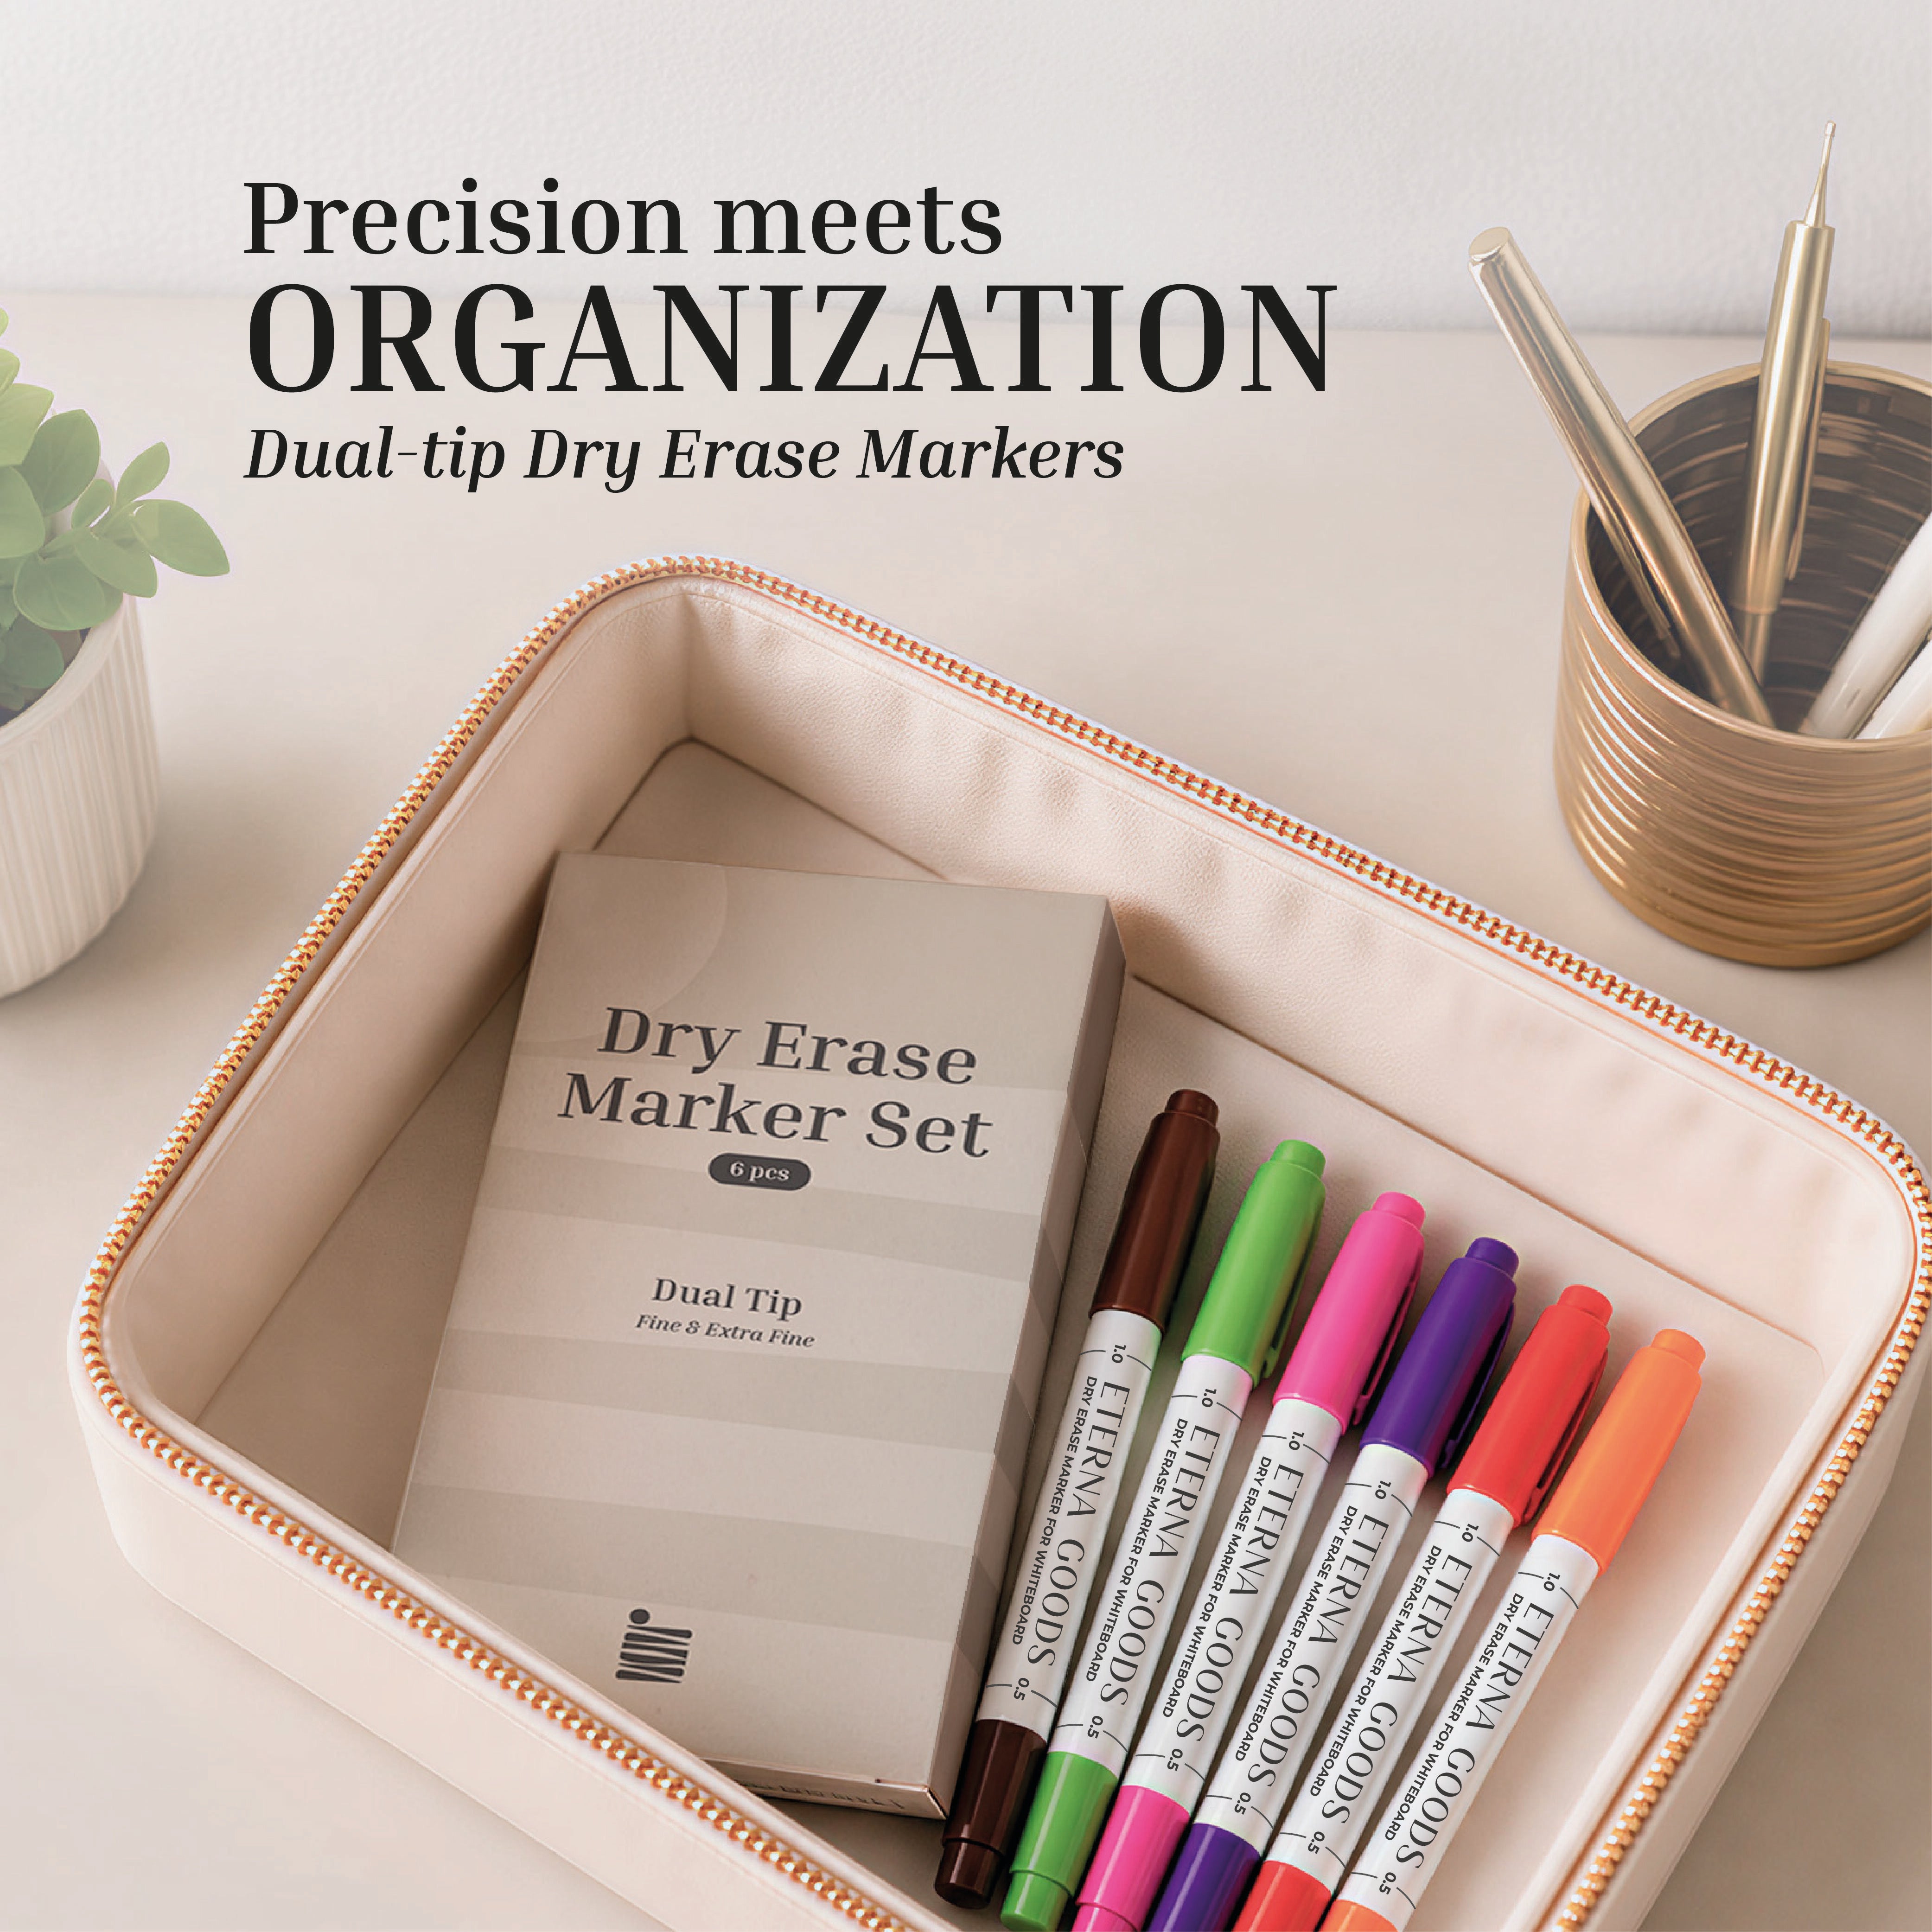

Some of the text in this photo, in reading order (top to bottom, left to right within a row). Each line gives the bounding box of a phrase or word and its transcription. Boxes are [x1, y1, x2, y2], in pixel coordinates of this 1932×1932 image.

[597, 1007, 976, 1084] Dry Erase
[557, 1072, 993, 1157] Marker Set
[730, 1161, 790, 1182] 6 pcs
[652, 1278, 801, 1322] Dual Tip
[636, 1315, 814, 1348] Fine & Extra Fine
[1111, 1345, 1127, 1364] 1.0
[1201, 1389, 1217, 1408] 1.0
[1288, 1431, 1306, 1451] 1.0
[1012, 1376, 1097, 1645] DRY ERASE MARKER FOR WHITEBOARD
[1375, 1480, 1391, 1499] 1.0
[1027, 1382, 1130, 1666] ETERNA GOODS
[1462, 1524, 1480, 1542] 1.0
[1086, 1418, 1188, 1682] DRY ERASE MARKER FOR WHITEBOARD
[1100, 1425, 1221, 1705] ETERNA GOODS
[1163, 1456, 1272, 1717] DRY ERASE MARKER FOR WHITEBOARD
[1176, 1464, 1304, 1741] ETERNA GOODS
[1542, 1573, 1562, 1591] 1.0
[1235, 1505, 1358, 1761] DRY ERASE MARKER FOR WHITEBOARD
[1248, 1514, 1390, 1787] ETERNA GOODS
[1014, 1677, 1030, 1701] 0.5
[1310, 1545, 1442, 1796] DRY ERASE MARKER FOR WHITEBOARD
[1322, 1554, 1473, 1824] ETERNA GOODS
[1087, 1715, 1105, 1739] 0.5
[1385, 1593, 1524, 1841] DRY ERASE MARKER FOR WHITEBOARD
[1396, 1602, 1554, 1868] ETERNA GOODS
[1167, 1748, 1183, 1772] 0.5
[1234, 1792, 1253, 1815] 0.5
[1307, 1831, 1325, 1854] 0.5
[1379, 1872, 1398, 1895] 0.5
